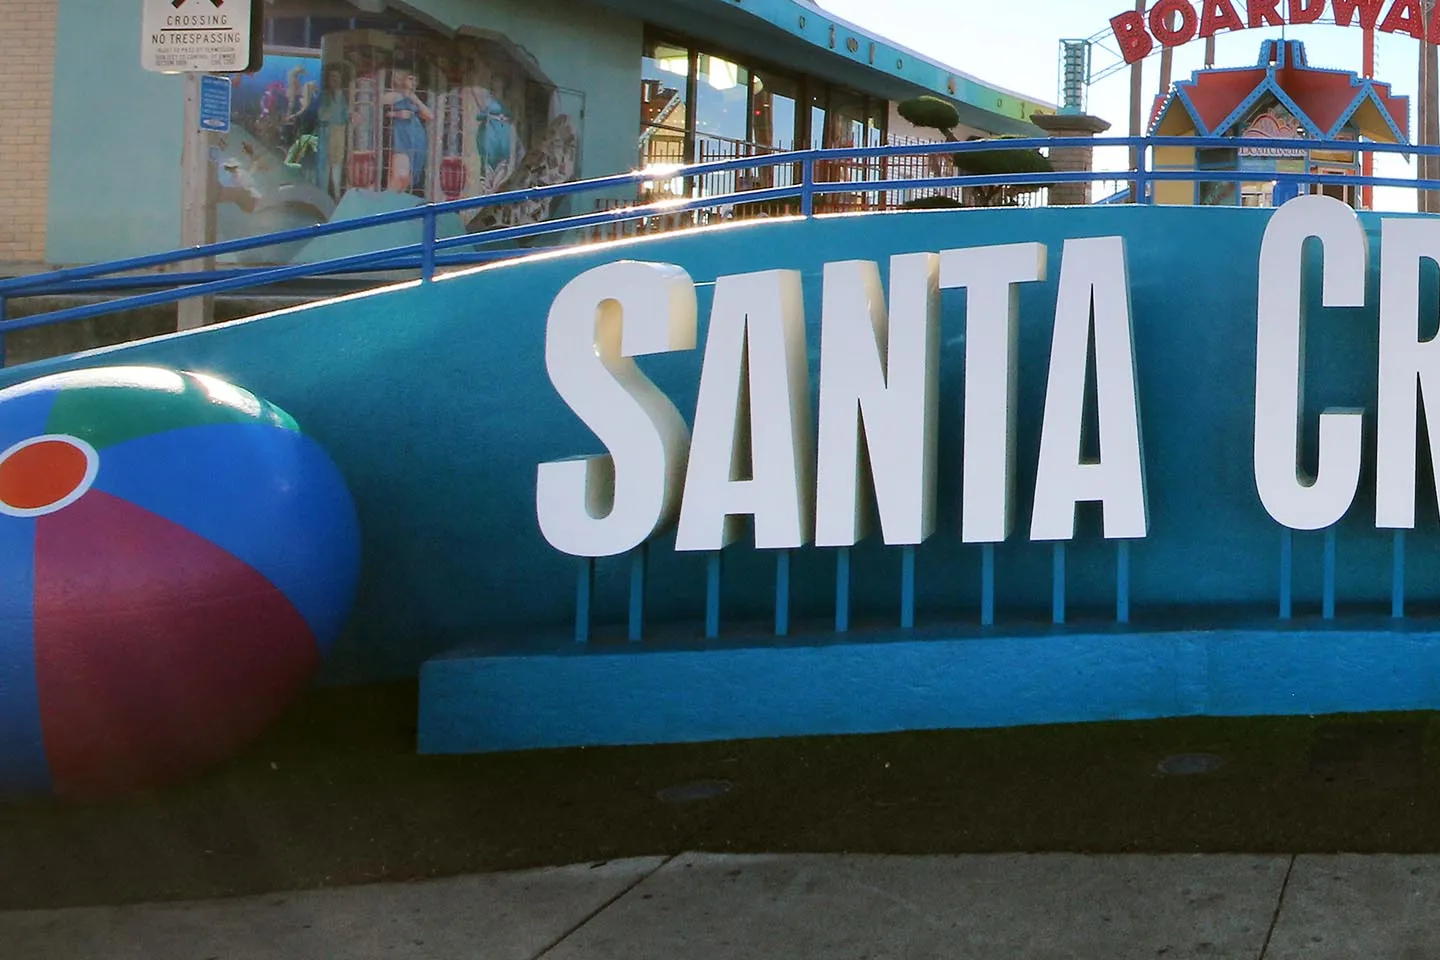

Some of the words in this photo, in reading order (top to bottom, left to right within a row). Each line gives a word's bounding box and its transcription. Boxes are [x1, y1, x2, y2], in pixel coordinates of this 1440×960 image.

[167, 15, 228, 27] CROSSING
[152, 34, 166, 44] NO
[170, 33, 241, 44] TRESPASSING
[536, 235, 1150, 558] SANTA
